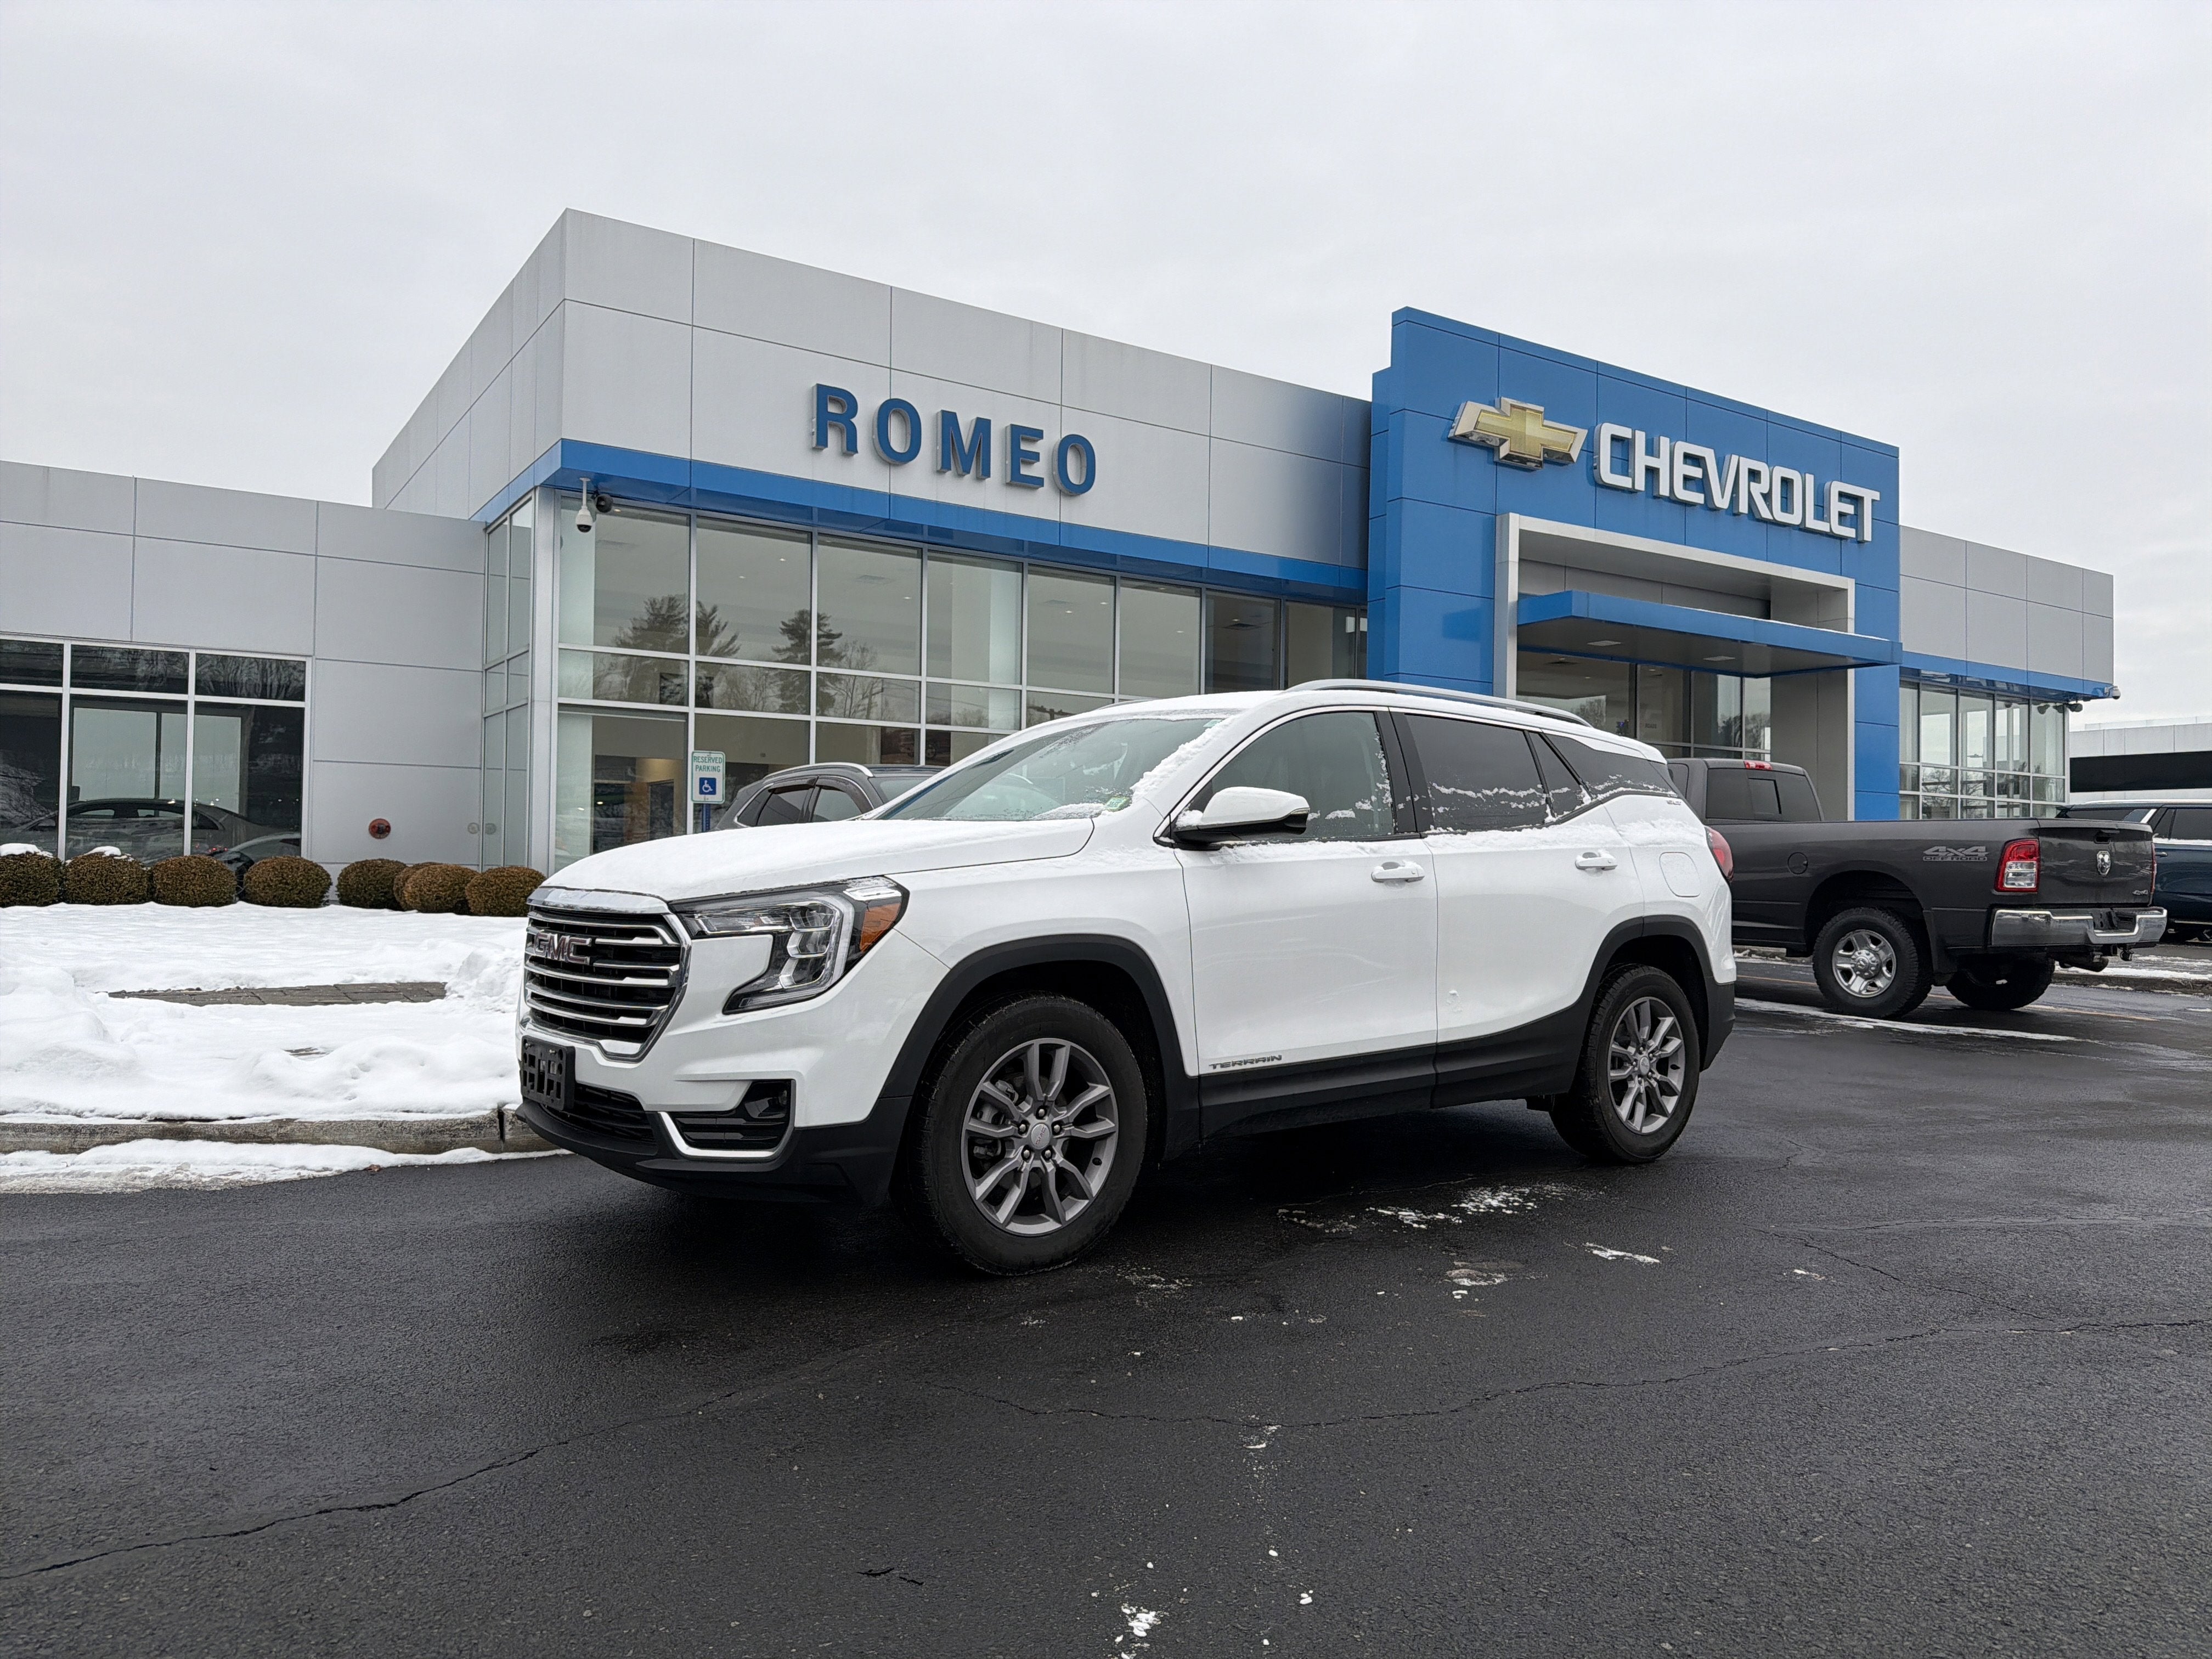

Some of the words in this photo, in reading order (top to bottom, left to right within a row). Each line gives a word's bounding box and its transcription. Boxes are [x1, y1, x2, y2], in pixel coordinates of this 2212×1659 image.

[812, 383, 1096, 496] ROMEO
[1593, 422, 1880, 543] CHEVROLET
[534, 933, 592, 966] GMC
[1209, 1054, 1282, 1070] TERRAIN
